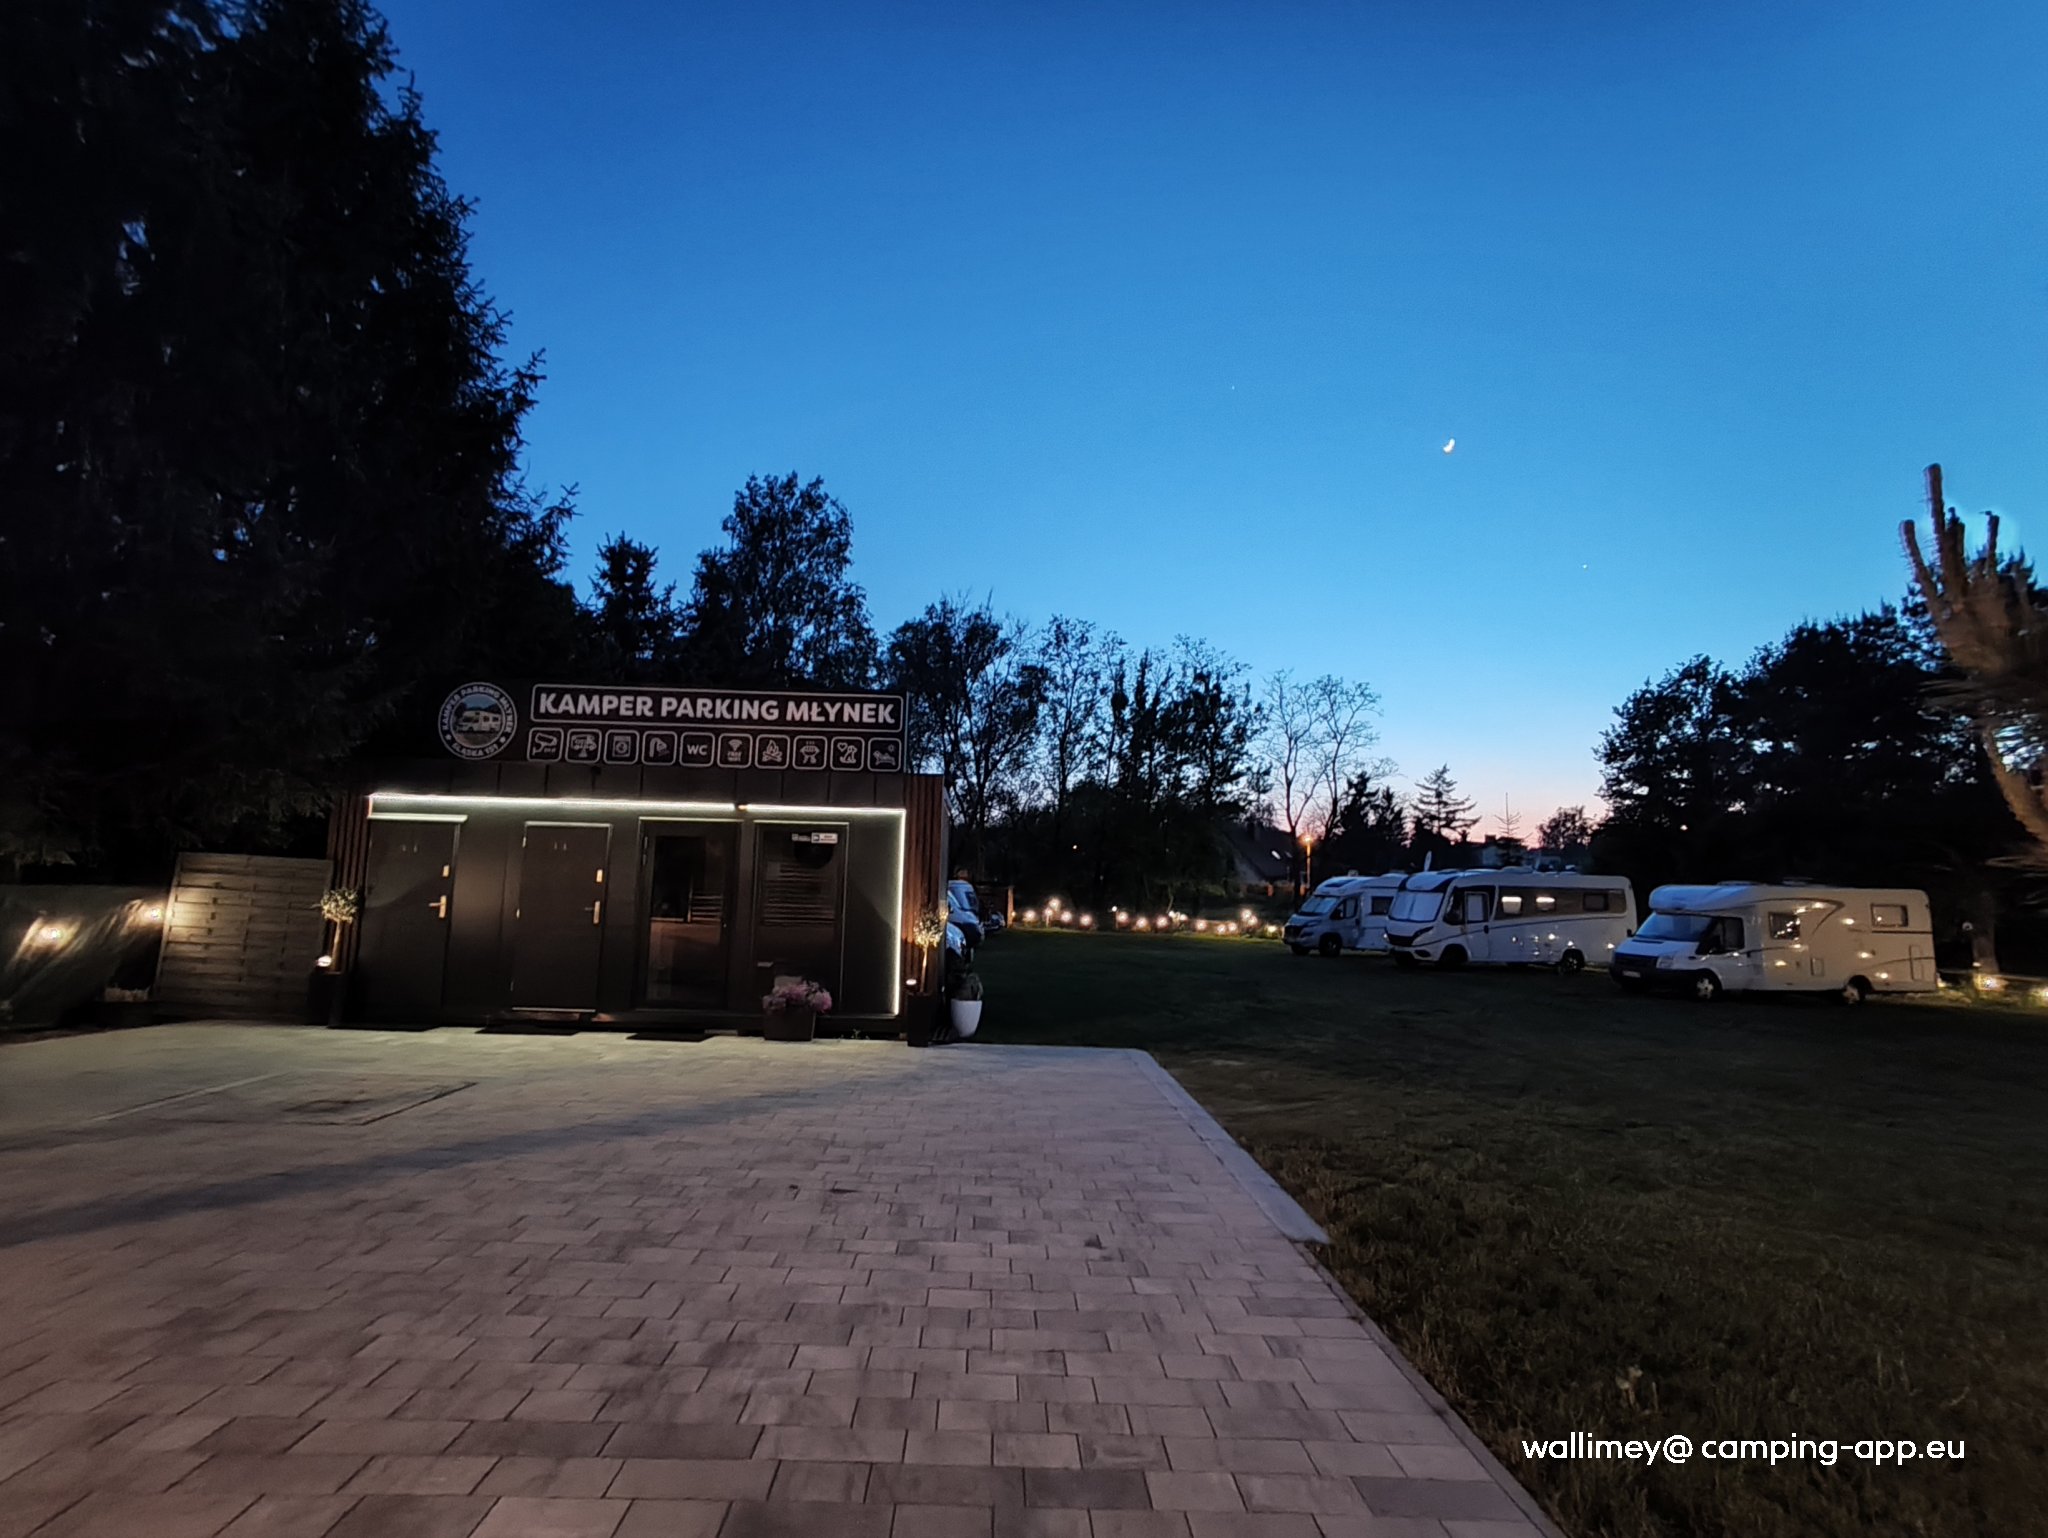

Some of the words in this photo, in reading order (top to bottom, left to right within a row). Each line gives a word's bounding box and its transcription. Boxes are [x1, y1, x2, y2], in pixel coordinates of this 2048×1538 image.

[442, 694, 461, 730] KAMPER
[461, 686, 501, 698] PARKING
[539, 693, 654, 717] KAMPER
[660, 696, 779, 721] PARKING
[785, 700, 896, 724] MŁYNEK
[687, 744, 708, 756] WC
